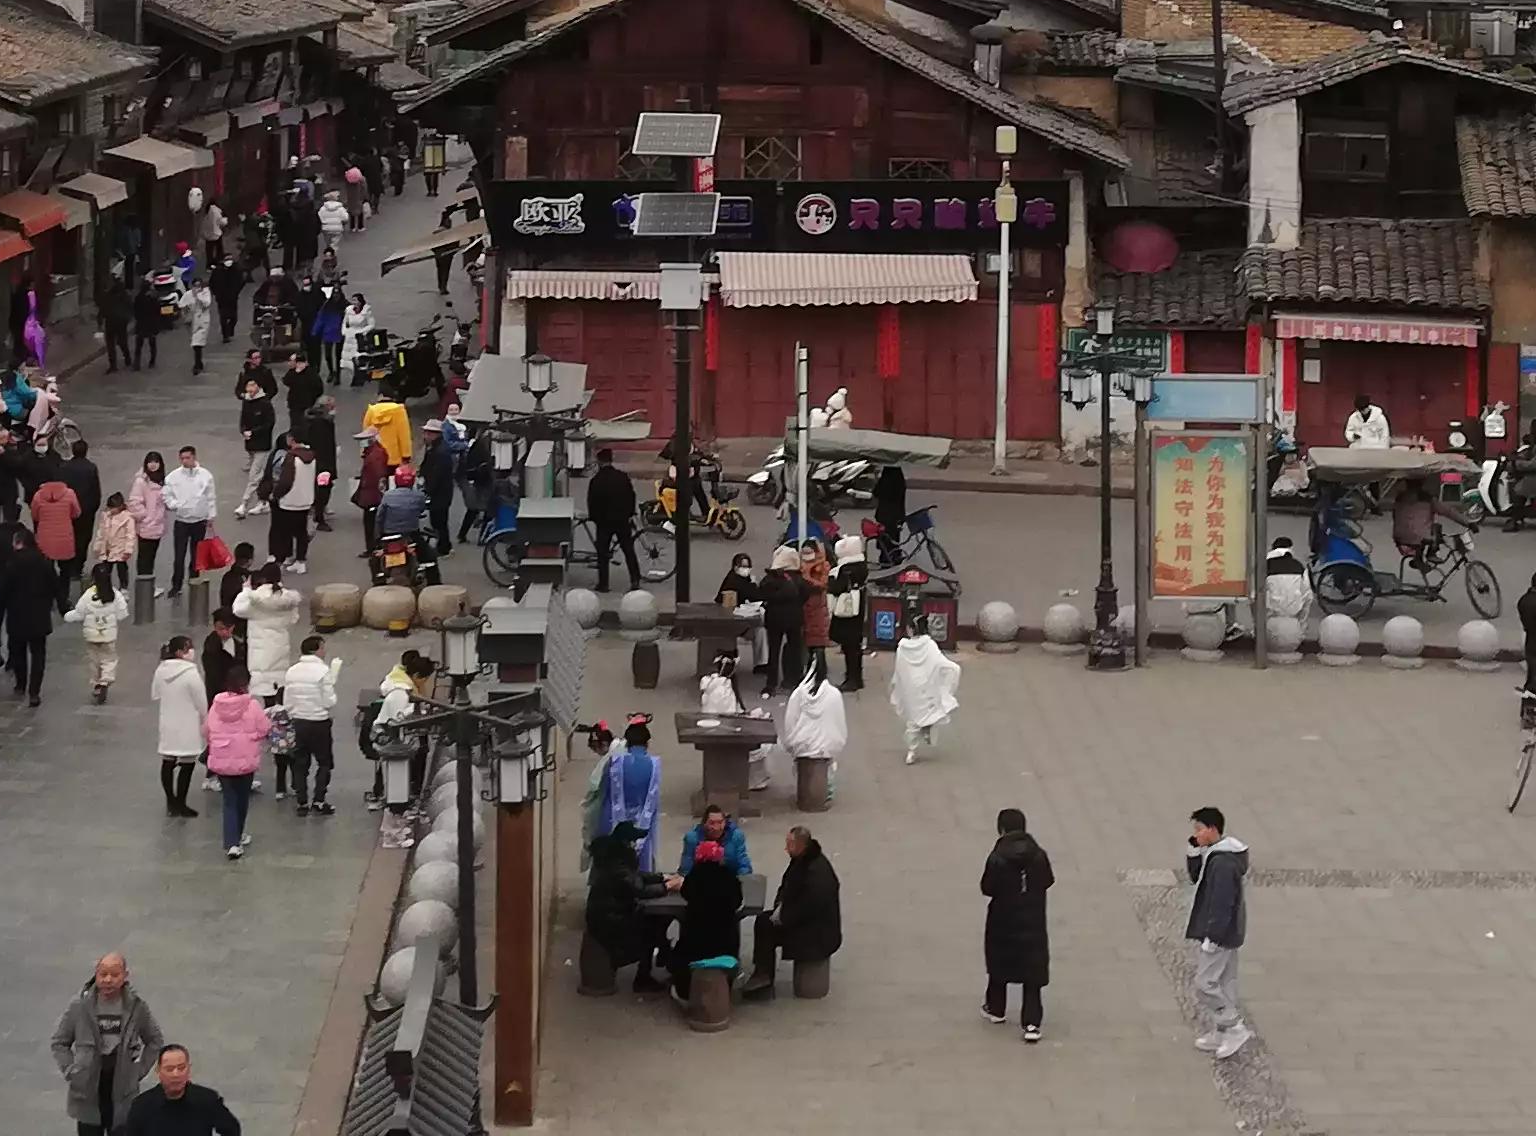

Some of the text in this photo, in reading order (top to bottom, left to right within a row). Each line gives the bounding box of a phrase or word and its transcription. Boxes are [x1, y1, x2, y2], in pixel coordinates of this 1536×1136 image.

[1173, 457, 1194, 585] 知法守法用法
[1206, 455, 1226, 585] 为你为我为大家
